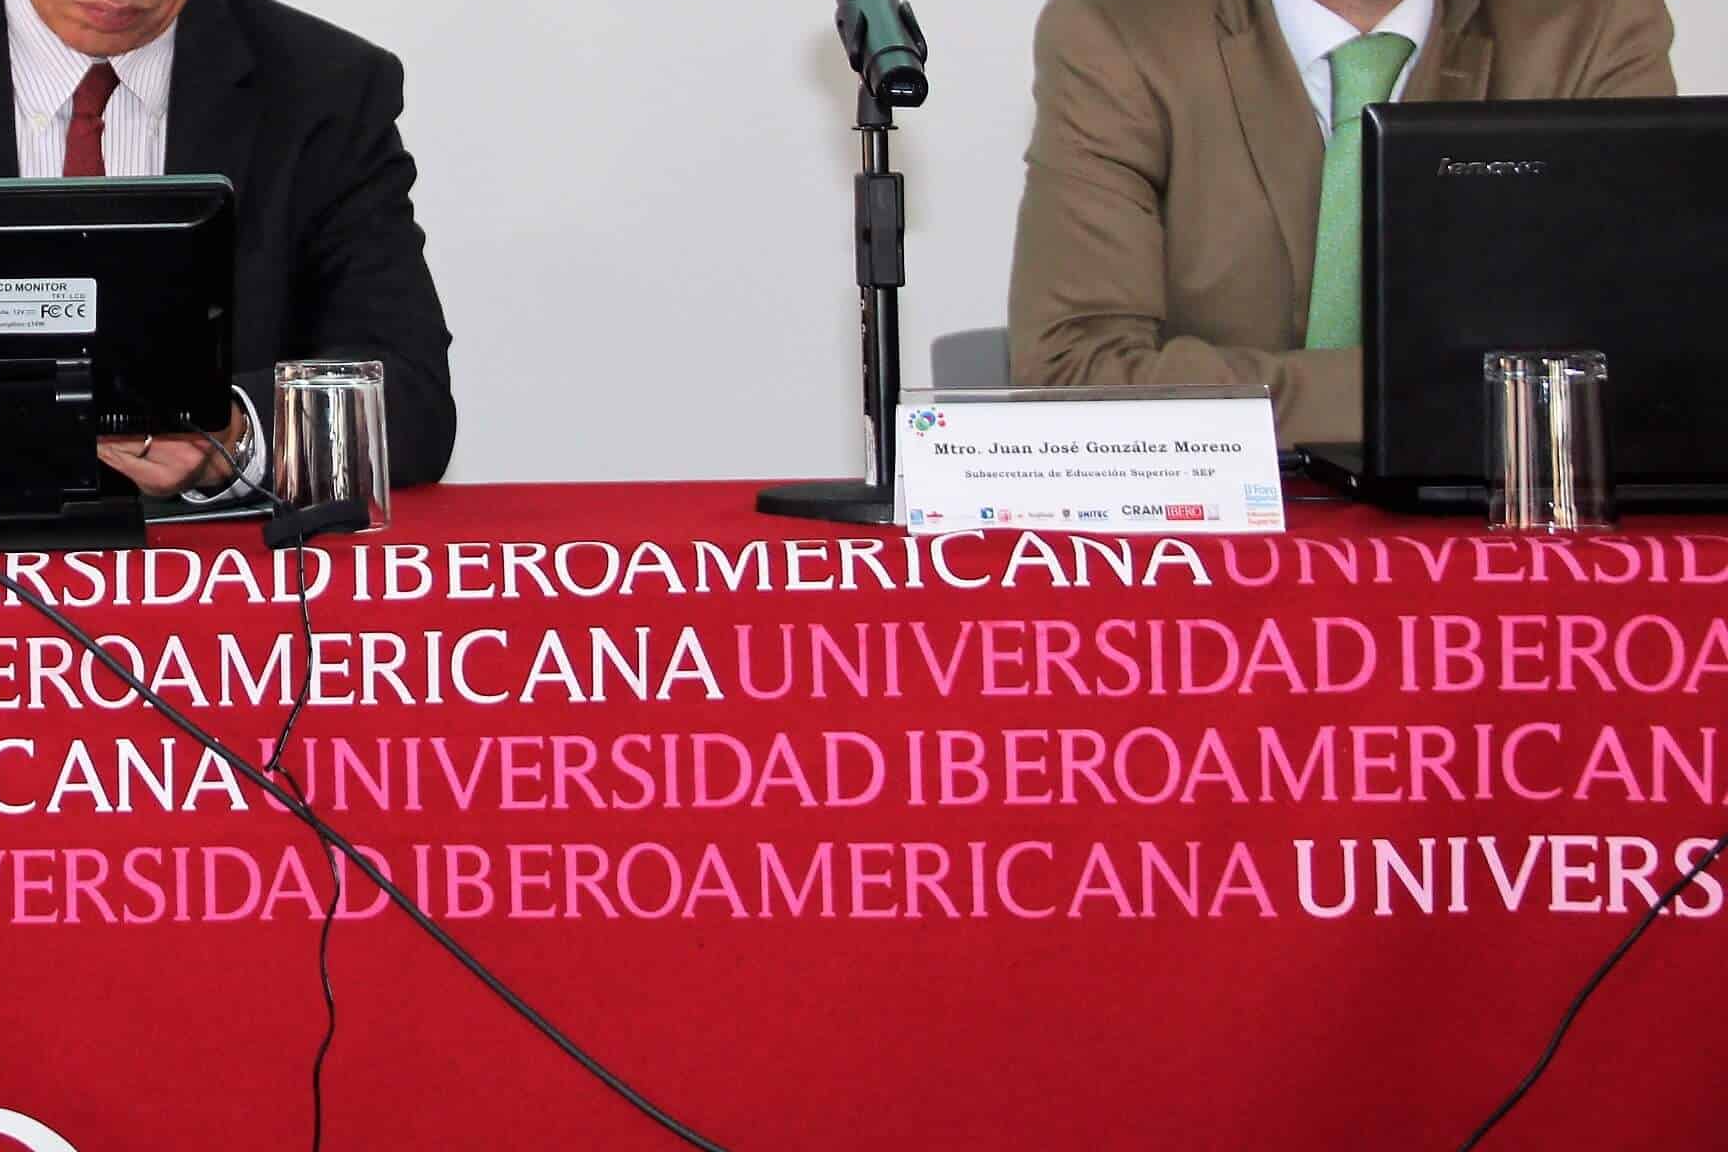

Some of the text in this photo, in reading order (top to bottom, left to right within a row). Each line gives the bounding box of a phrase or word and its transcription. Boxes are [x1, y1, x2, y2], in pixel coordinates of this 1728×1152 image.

[15, 282, 68, 292] MONITOR
[934, 440, 1242, 455] Mtro. Juan José González Moreno
[1131, 468, 1181, 480] Superior
[1121, 504, 1164, 516] CRAM
[1166, 505, 1204, 519] IBERO
[352, 531, 1213, 601] IBEROAMERICANA
[735, 617, 1377, 700] UNIVERSIDAD
[259, 732, 886, 814] UNIVERSIDAD
[906, 723, 1728, 805] IBEROAMERICAN
[414, 841, 1278, 919] IBEROAMERICANA
[1294, 835, 1726, 920] UNIVERS
